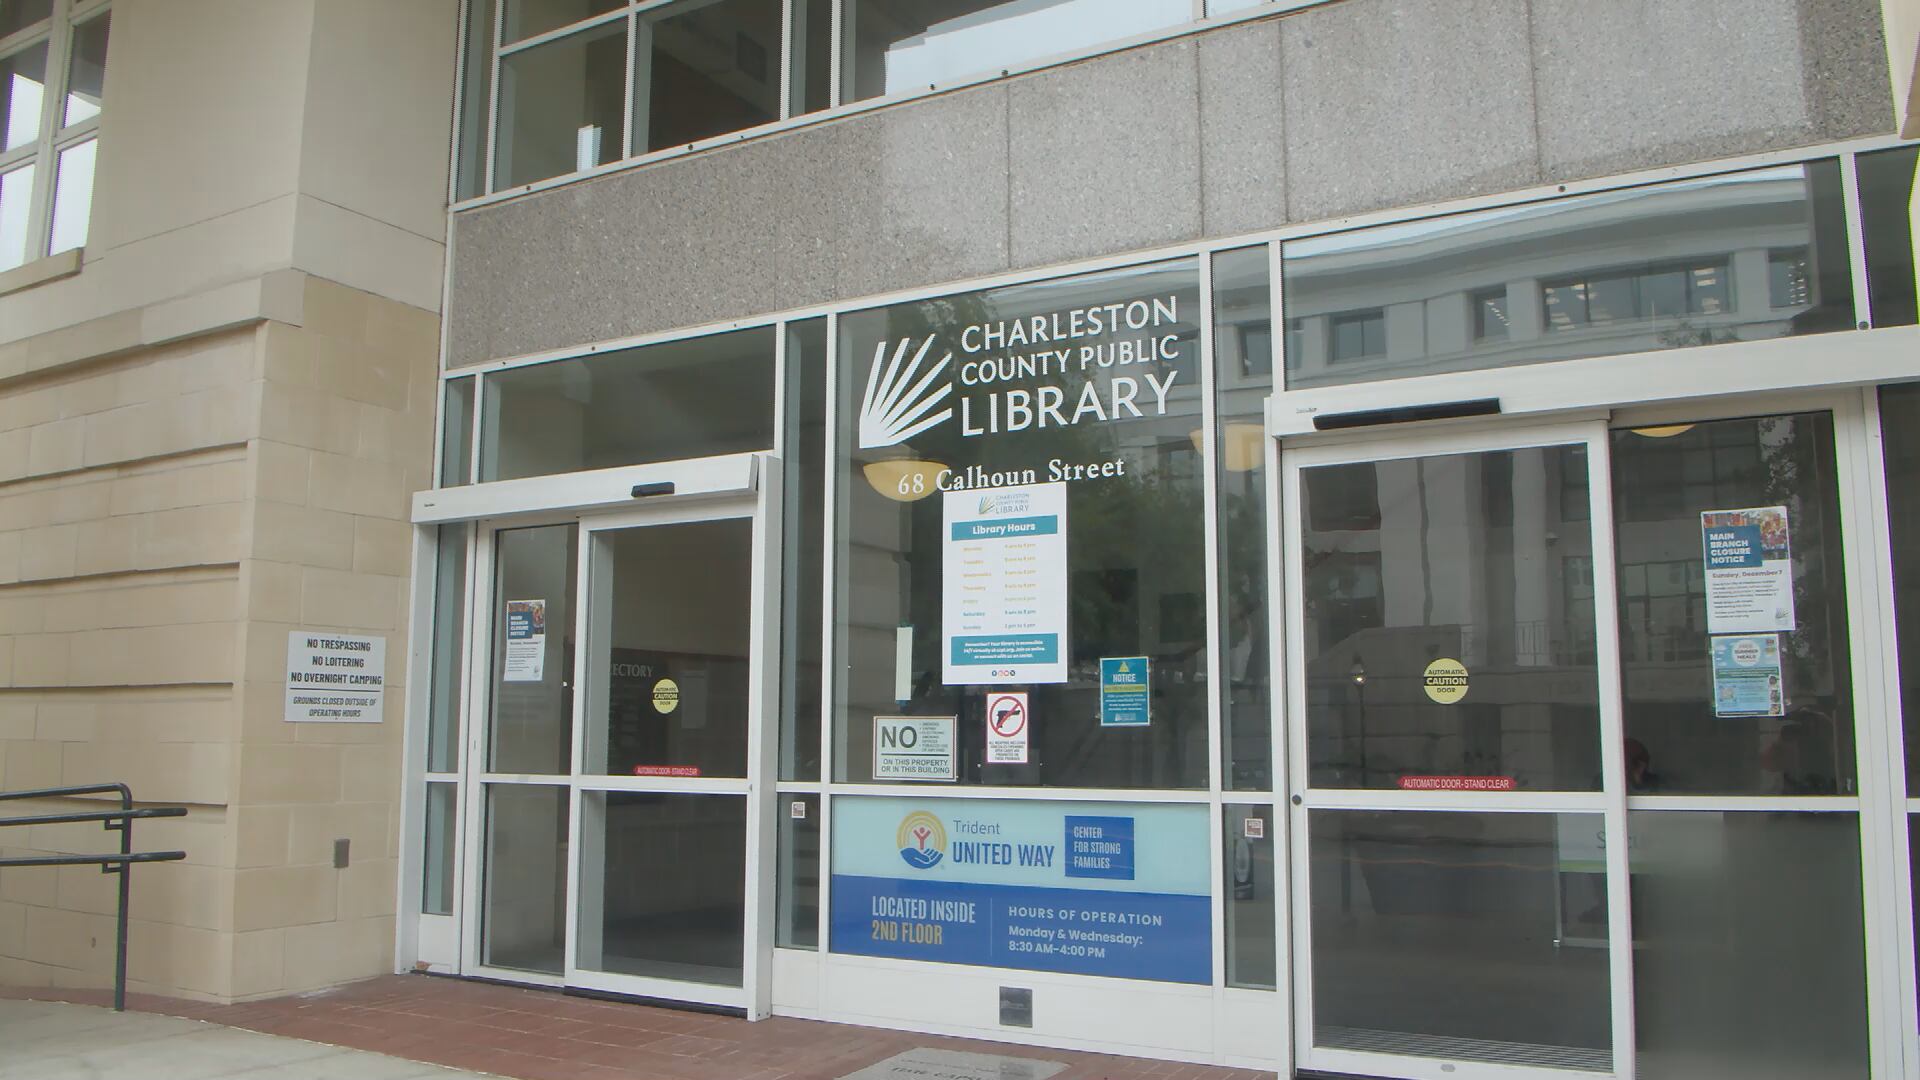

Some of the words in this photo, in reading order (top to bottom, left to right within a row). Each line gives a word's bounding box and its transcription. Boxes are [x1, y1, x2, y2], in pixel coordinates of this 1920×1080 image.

[961, 296, 1178, 353] CHARLESTON
[961, 349, 1072, 387] COUNTY
[1080, 334, 1179, 371] PUBLIC
[961, 370, 1178, 437] LIBRARY
[898, 473, 925, 495] 68
[935, 466, 1037, 492] Calhoun
[1048, 458, 1126, 484] Street
[996, 505, 1030, 514] LIBRARY
[972, 524, 1006, 536] Library
[1007, 523, 1036, 533] Hours
[1710, 540, 1749, 548] BRANCH
[1711, 548, 1751, 556] CLOSURE
[1711, 556, 1745, 564] NOTICE
[307, 638, 318, 648] NO
[320, 639, 371, 651] TRESPASSING
[312, 656, 323, 666] NO
[325, 657, 364, 668] LOITERING
[611, 664, 654, 678] ECTORY
[291, 672, 302, 682] NO
[304, 673, 348, 684] OVERNIGHT
[349, 675, 382, 685] CAMPING
[1113, 673, 1137, 683] NOTICE
[1426, 677, 1467, 685] CAUTION
[293, 696, 321, 705] GROUNDS
[322, 697, 344, 705] CLOSED
[345, 698, 368, 706] OUTSIDE
[369, 698, 377, 706] OF
[309, 709, 341, 717] OPERATING
[342, 709, 361, 717] HOURS
[881, 726, 918, 748] NO
[911, 759, 949, 767] PROPERTY
[917, 766, 950, 774] BUILDING
[1403, 779, 1440, 788] AUTOMATIC
[1441, 779, 1461, 788] DOOR
[1465, 780, 1486, 788] STAND
[1487, 780, 1509, 788] CLEAR
[953, 819, 1000, 835] Trident
[1073, 826, 1103, 839] CENTER
[952, 841, 1012, 866] UNITED
[1018, 845, 1055, 868] WAY
[1073, 841, 1089, 854] FOR
[1090, 842, 1121, 855] STRONG
[1073, 856, 1111, 869] FAMILIES
[872, 896, 927, 920] LOCATED
[930, 900, 976, 924] INSIDE
[1008, 906, 1054, 920] HOURS
[1059, 909, 1076, 921] OF
[1080, 909, 1163, 927] OPERATION
[871, 919, 898, 942] 2ND
[901, 922, 943, 945] FLOOR
[1008, 925, 1055, 941] Monday
[1057, 928, 1066, 940] &
[1068, 928, 1143, 947] Wednesday:
[1008, 940, 1033, 952] 8:30
[1087, 946, 1106, 958] PM
